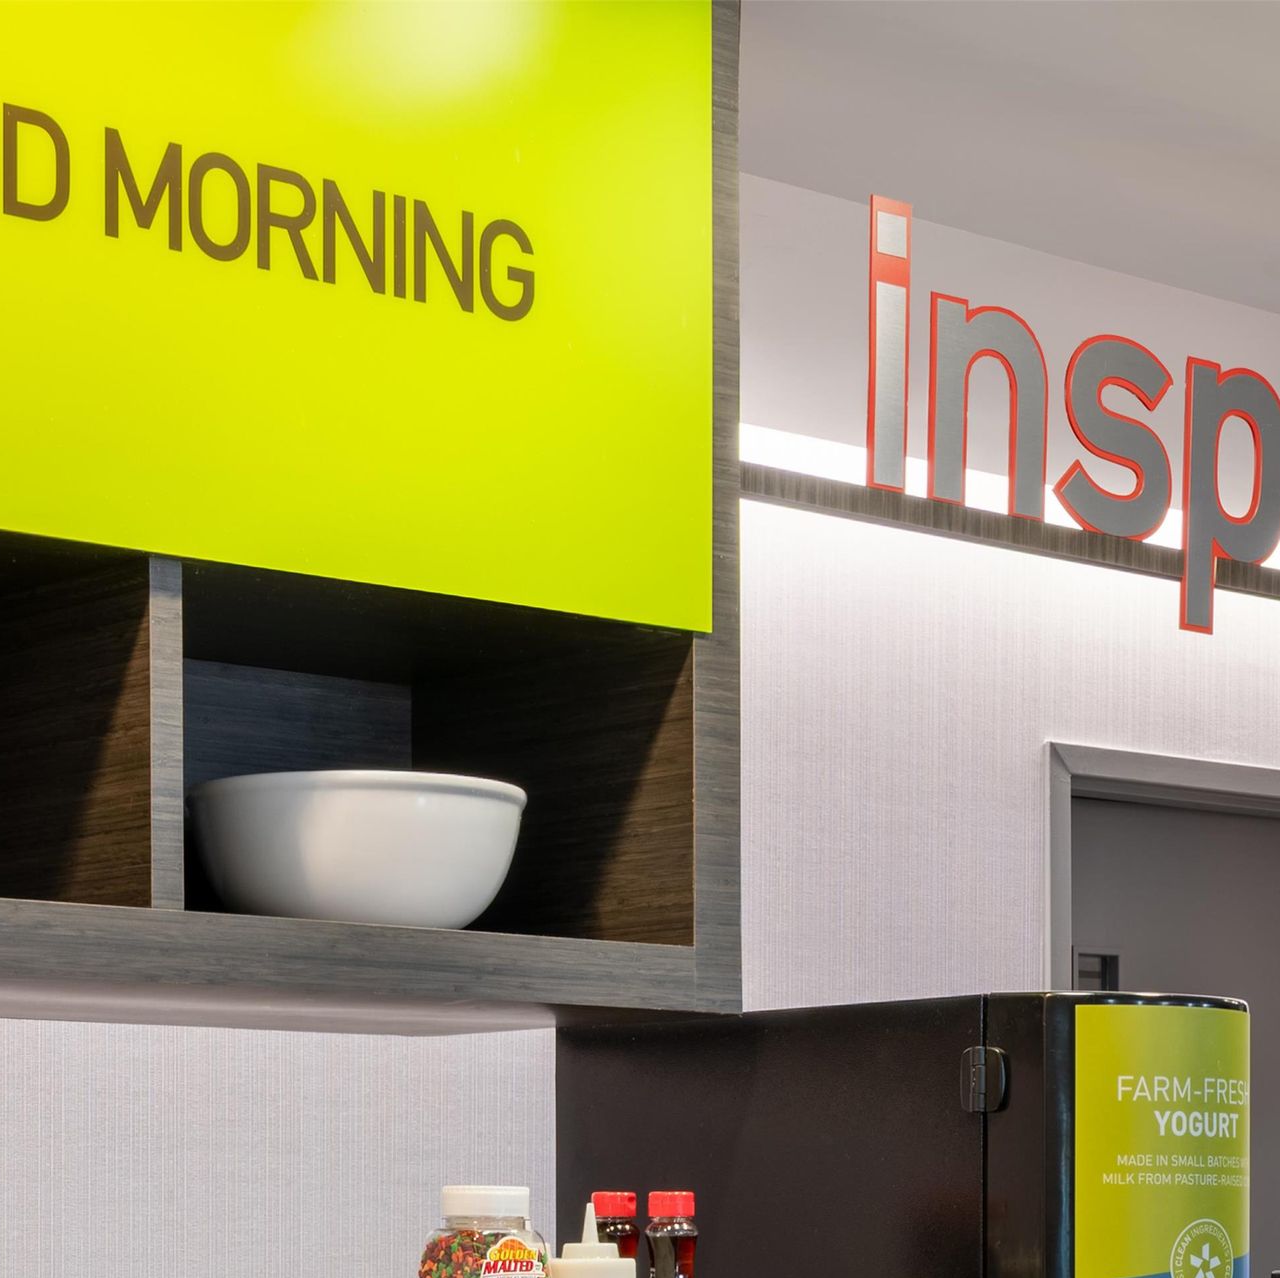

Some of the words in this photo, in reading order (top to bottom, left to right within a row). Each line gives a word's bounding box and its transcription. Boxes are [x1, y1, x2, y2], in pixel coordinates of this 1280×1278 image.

[104, 126, 536, 322] MORNING
[1154, 1110, 1239, 1138] YOGURT
[1117, 1154, 1153, 1167] MADE
[1156, 1155, 1168, 1167] IN
[1171, 1155, 1205, 1168] SMALL
[1207, 1155, 1240, 1168] BATCHES
[1103, 1173, 1135, 1185] MILK
[1138, 1173, 1172, 1185] FROM
[489, 1247, 537, 1260] GOLDEN
[1175, 1233, 1192, 1267] CLEAN
[483, 1260, 534, 1274] MALTED
